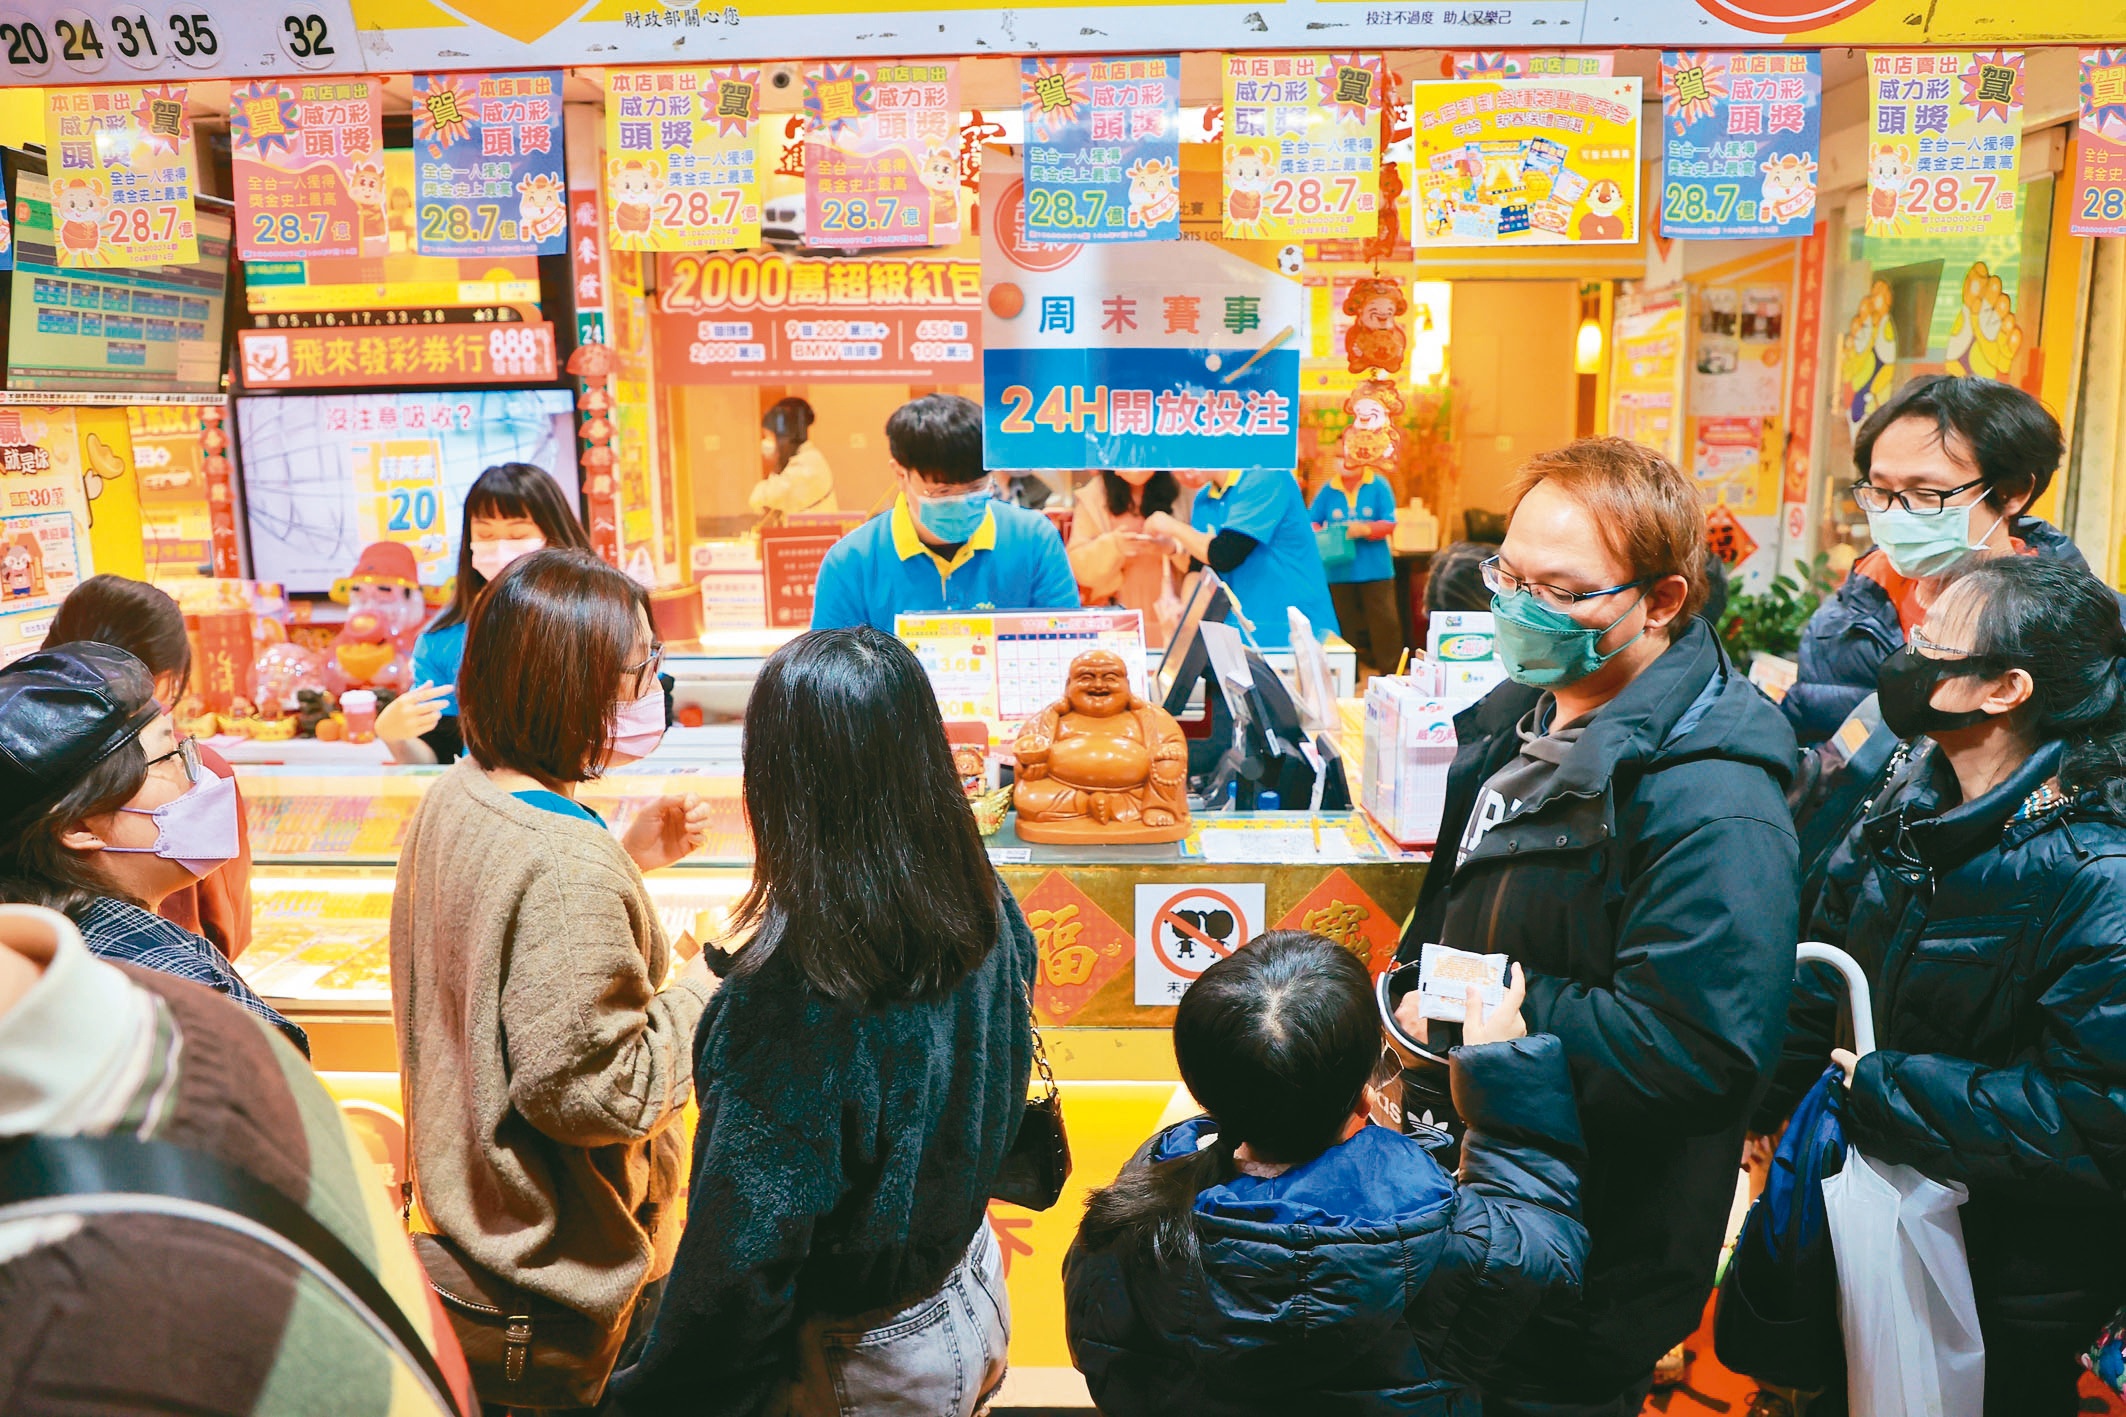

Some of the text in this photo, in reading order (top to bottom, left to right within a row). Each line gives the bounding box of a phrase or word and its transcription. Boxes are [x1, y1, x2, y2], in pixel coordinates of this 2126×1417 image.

[624, 7, 741, 29] 財政部關心您
[1366, 10, 1512, 25] 投注不過度 助人又樂己
[1, 14, 335, 64] 20 24 31 35 32
[877, 67, 947, 82] 本店賣出
[1091, 60, 1167, 81] 本店賣出
[1230, 58, 1315, 76] 本店賣出
[1529, 57, 1599, 75] 本店賣出
[1730, 55, 1807, 74] 本店賣出
[1873, 56, 1959, 74] 本店賣出
[302, 84, 368, 100] 本店賣出
[480, 78, 552, 97] 本店賣出
[613, 74, 697, 91] 本店賣出
[1034, 73, 1072, 112] 賀
[1093, 84, 1163, 107] 威力彩
[1236, 81, 1308, 102] 威力彩
[1337, 67, 1371, 105] 賀
[1674, 67, 1710, 107] 賀
[1732, 79, 1803, 100] 威力彩
[1879, 78, 1950, 100] 威力彩
[1978, 66, 2014, 104] 賀
[2091, 66, 2126, 108] 賀
[51, 94, 130, 111] 本店賣出
[427, 91, 463, 130] 賀
[620, 96, 691, 116] 威力彩
[720, 83, 751, 118] 賀
[817, 80, 860, 121] 賀
[878, 87, 946, 107] 威力彩
[1420, 89, 1632, 130] 本店刮刮樂種類豐富齊全
[152, 101, 181, 136] 賀
[244, 97, 285, 138] 賀
[303, 103, 369, 125] 威力彩
[482, 101, 549, 122] 威力彩
[1092, 110, 1163, 140] 頭獎
[1728, 105, 1804, 134] 頭獎
[1877, 104, 1949, 134] 頭獎
[60, 115, 127, 136] 威力彩
[620, 121, 693, 150] 頭獎
[877, 112, 946, 139] 頭獎
[304, 128, 371, 156] 頭獎
[483, 126, 550, 155] 頭獎
[1917, 155, 2014, 171] 獎金史上最高
[1039, 295, 1261, 334] 周末賽事
[292, 334, 486, 377] 飛來發彩券行
[1001, 385, 1289, 435] 24H開放投注
[388, 487, 436, 530] 20
[1028, 903, 1099, 987] 福
